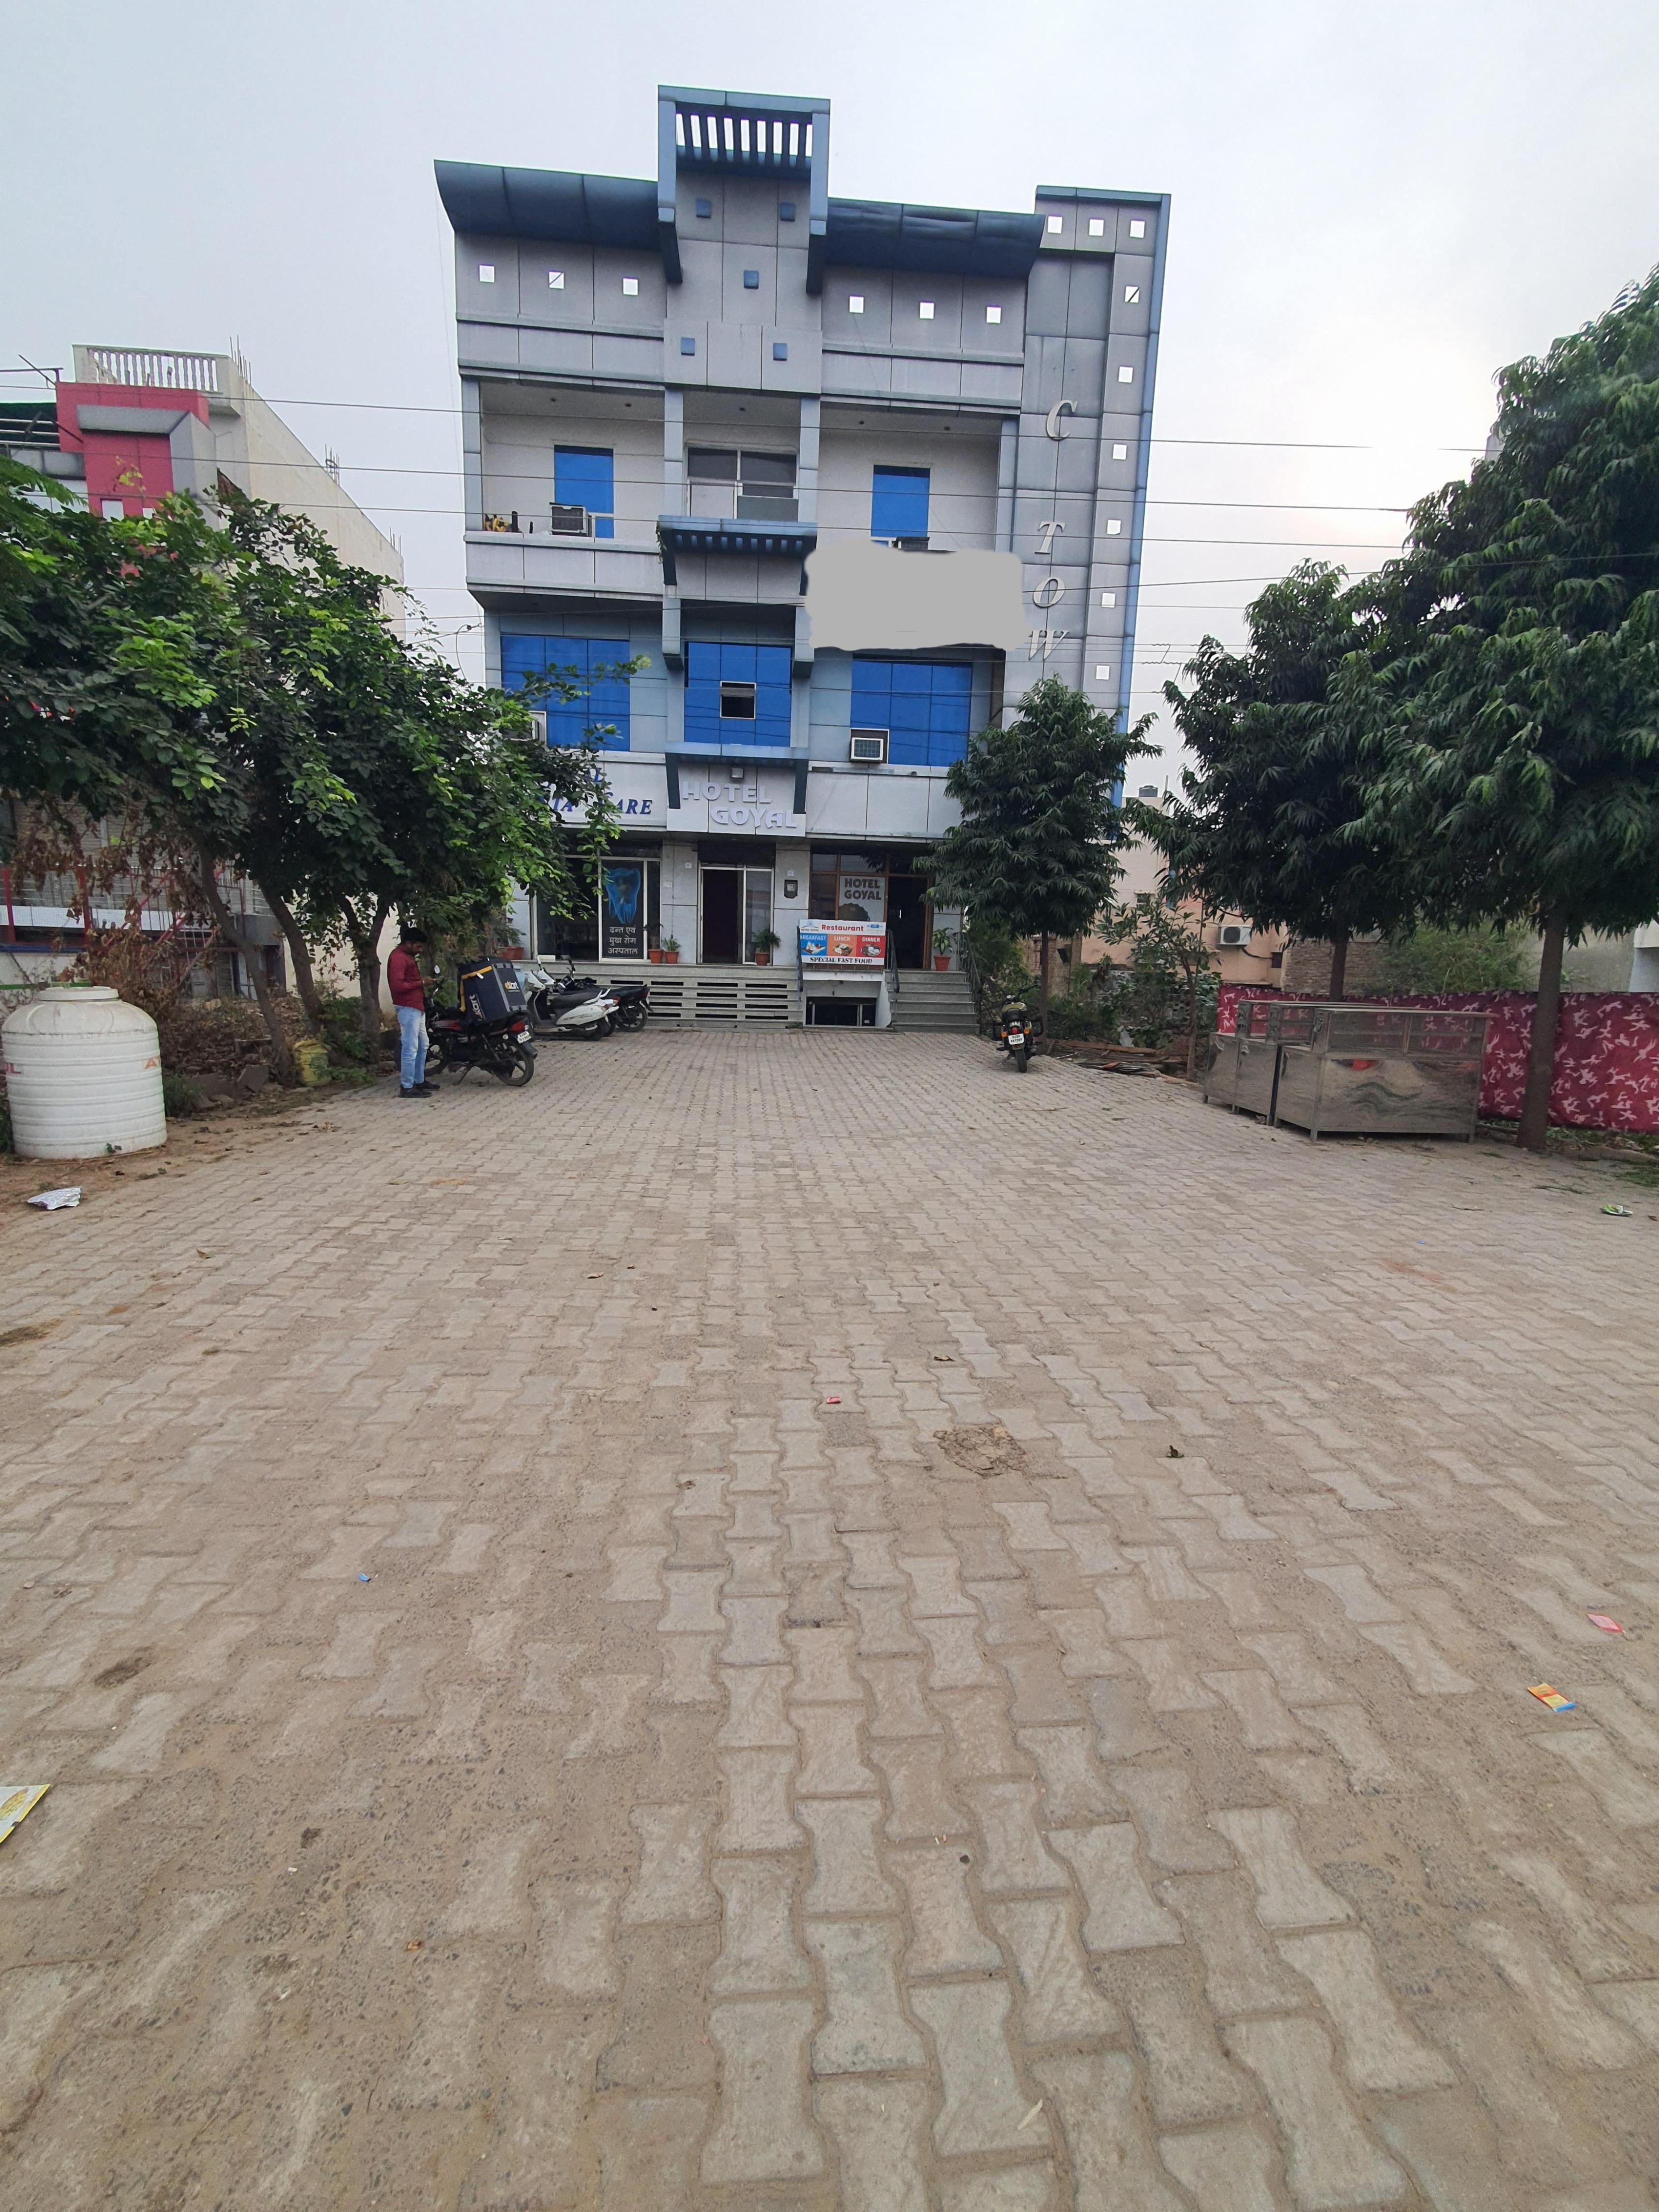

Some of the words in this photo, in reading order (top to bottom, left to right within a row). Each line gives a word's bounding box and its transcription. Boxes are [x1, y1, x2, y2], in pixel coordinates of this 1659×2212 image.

[682, 781, 772, 804] HOTEL
[711, 807, 798, 828] GOYAL
[844, 878, 880, 889] HOTEL
[844, 890, 881, 901] GOYAL
[609, 937, 622, 946] मुख
[624, 935, 637, 944] रोग
